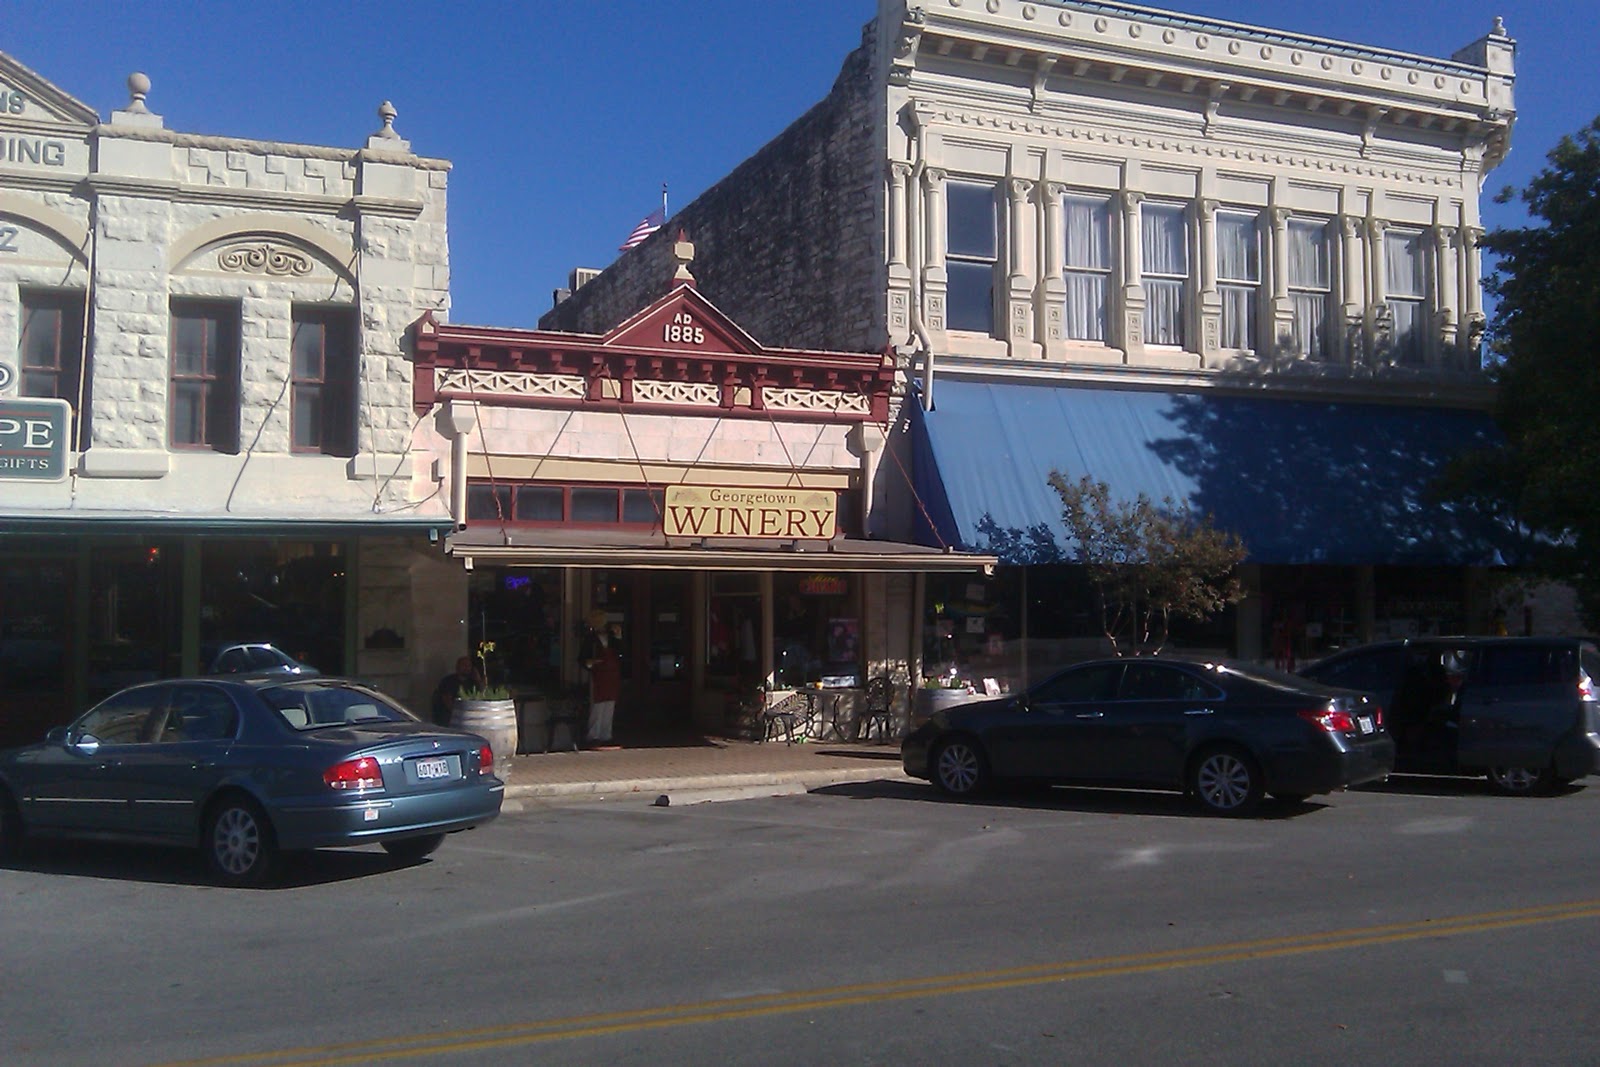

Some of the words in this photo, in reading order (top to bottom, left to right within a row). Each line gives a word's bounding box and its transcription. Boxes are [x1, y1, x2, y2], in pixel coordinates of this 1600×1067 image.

[0, 136, 65, 166] ING
[664, 324, 705, 344] 1885
[0, 457, 49, 470] GIFTS
[709, 488, 797, 506] Georgetown
[668, 505, 834, 537] WINERY
